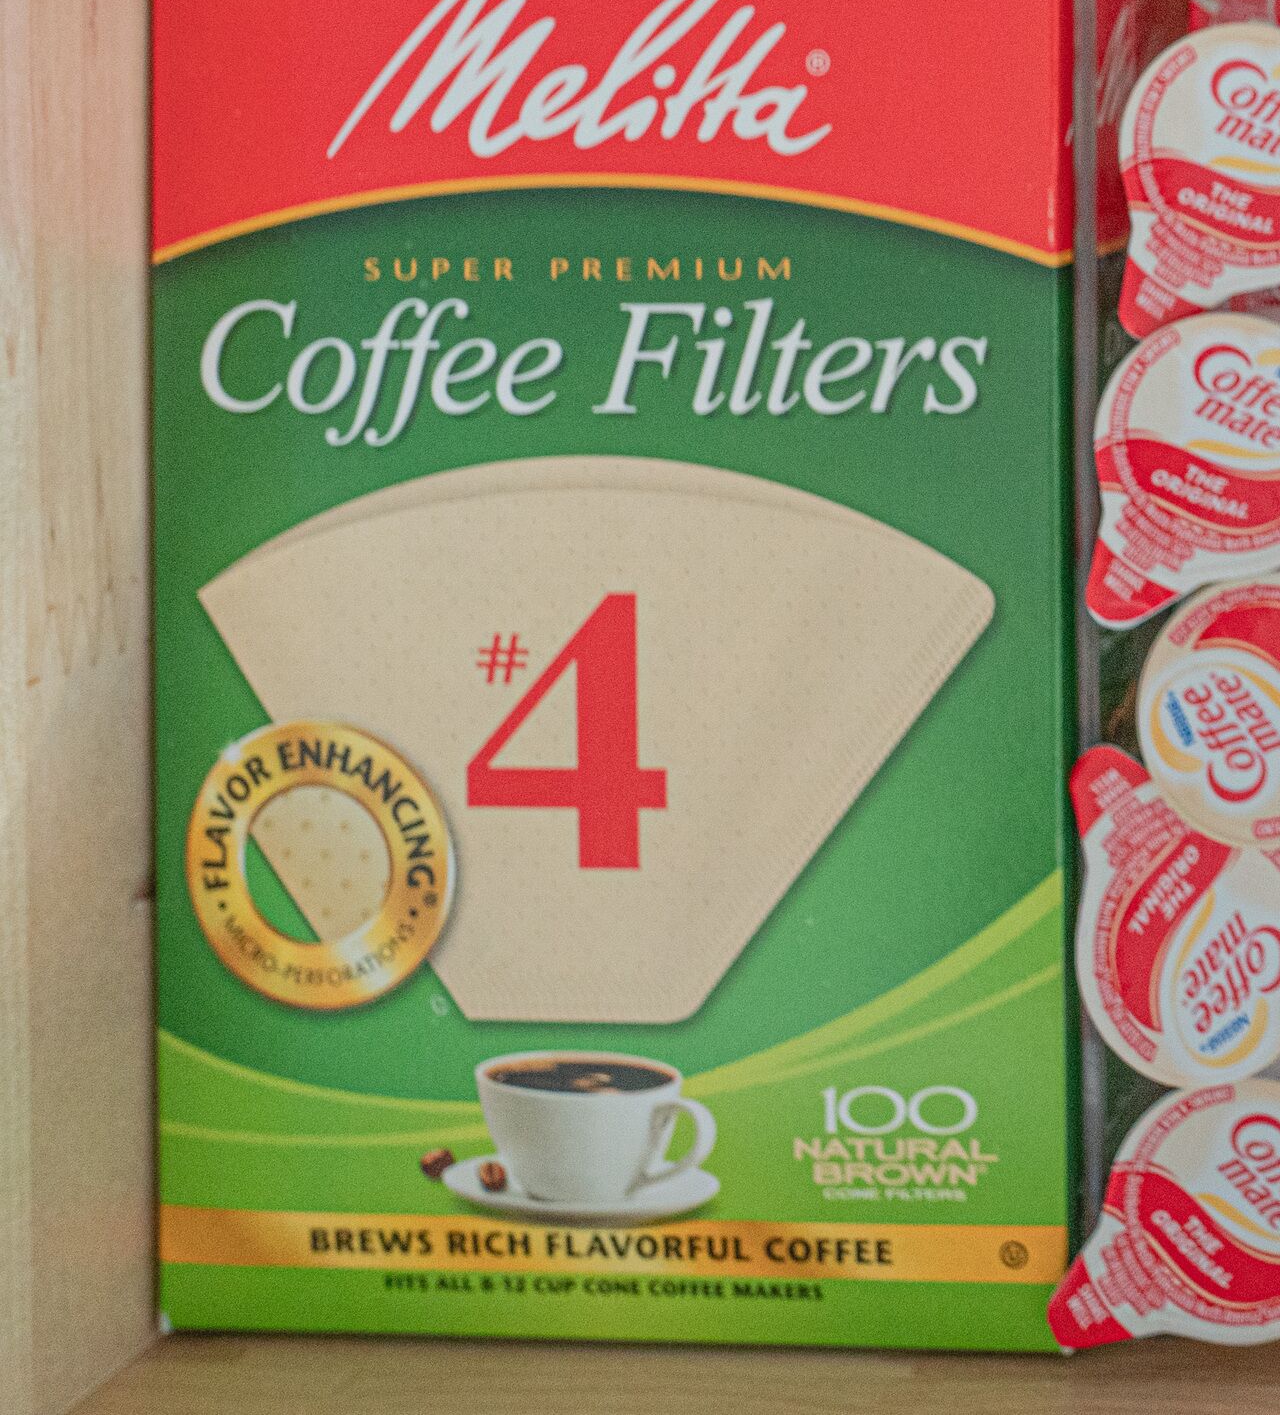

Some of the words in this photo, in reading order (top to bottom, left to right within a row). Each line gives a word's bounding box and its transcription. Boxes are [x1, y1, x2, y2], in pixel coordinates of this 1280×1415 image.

[1178, 188, 1274, 233] ORIGINAL
[1211, 181, 1251, 209] THE
[363, 257, 515, 282] SUPER
[550, 257, 794, 282] PREMIUM
[200, 297, 563, 446] Coffee
[592, 297, 988, 418] Filters
[1151, 470, 1249, 520] ORIGINAL
[1184, 466, 1228, 491] THE
[1184, 688, 1268, 803] Coffee
[203, 756, 272, 892] FLAVOR
[276, 738, 435, 889] ENHANCING
[1182, 913, 1248, 1006] mate
[821, 1085, 978, 1136] 100
[794, 1136, 998, 1164] NATURAL
[812, 1162, 980, 1186] BROWN
[885, 1187, 968, 1202] FILTERS
[311, 1229, 432, 1255] BREWS
[445, 1230, 532, 1258] RICH
[546, 1233, 750, 1262] FLAVORFUL
[766, 1237, 894, 1266] COFFEE
[385, 1274, 428, 1292] FITS
[434, 1277, 472, 1292] ALL
[534, 1278, 577, 1295] CUP
[650, 1279, 724, 1298] COFFEE
[735, 1282, 823, 1300] MAKERS
